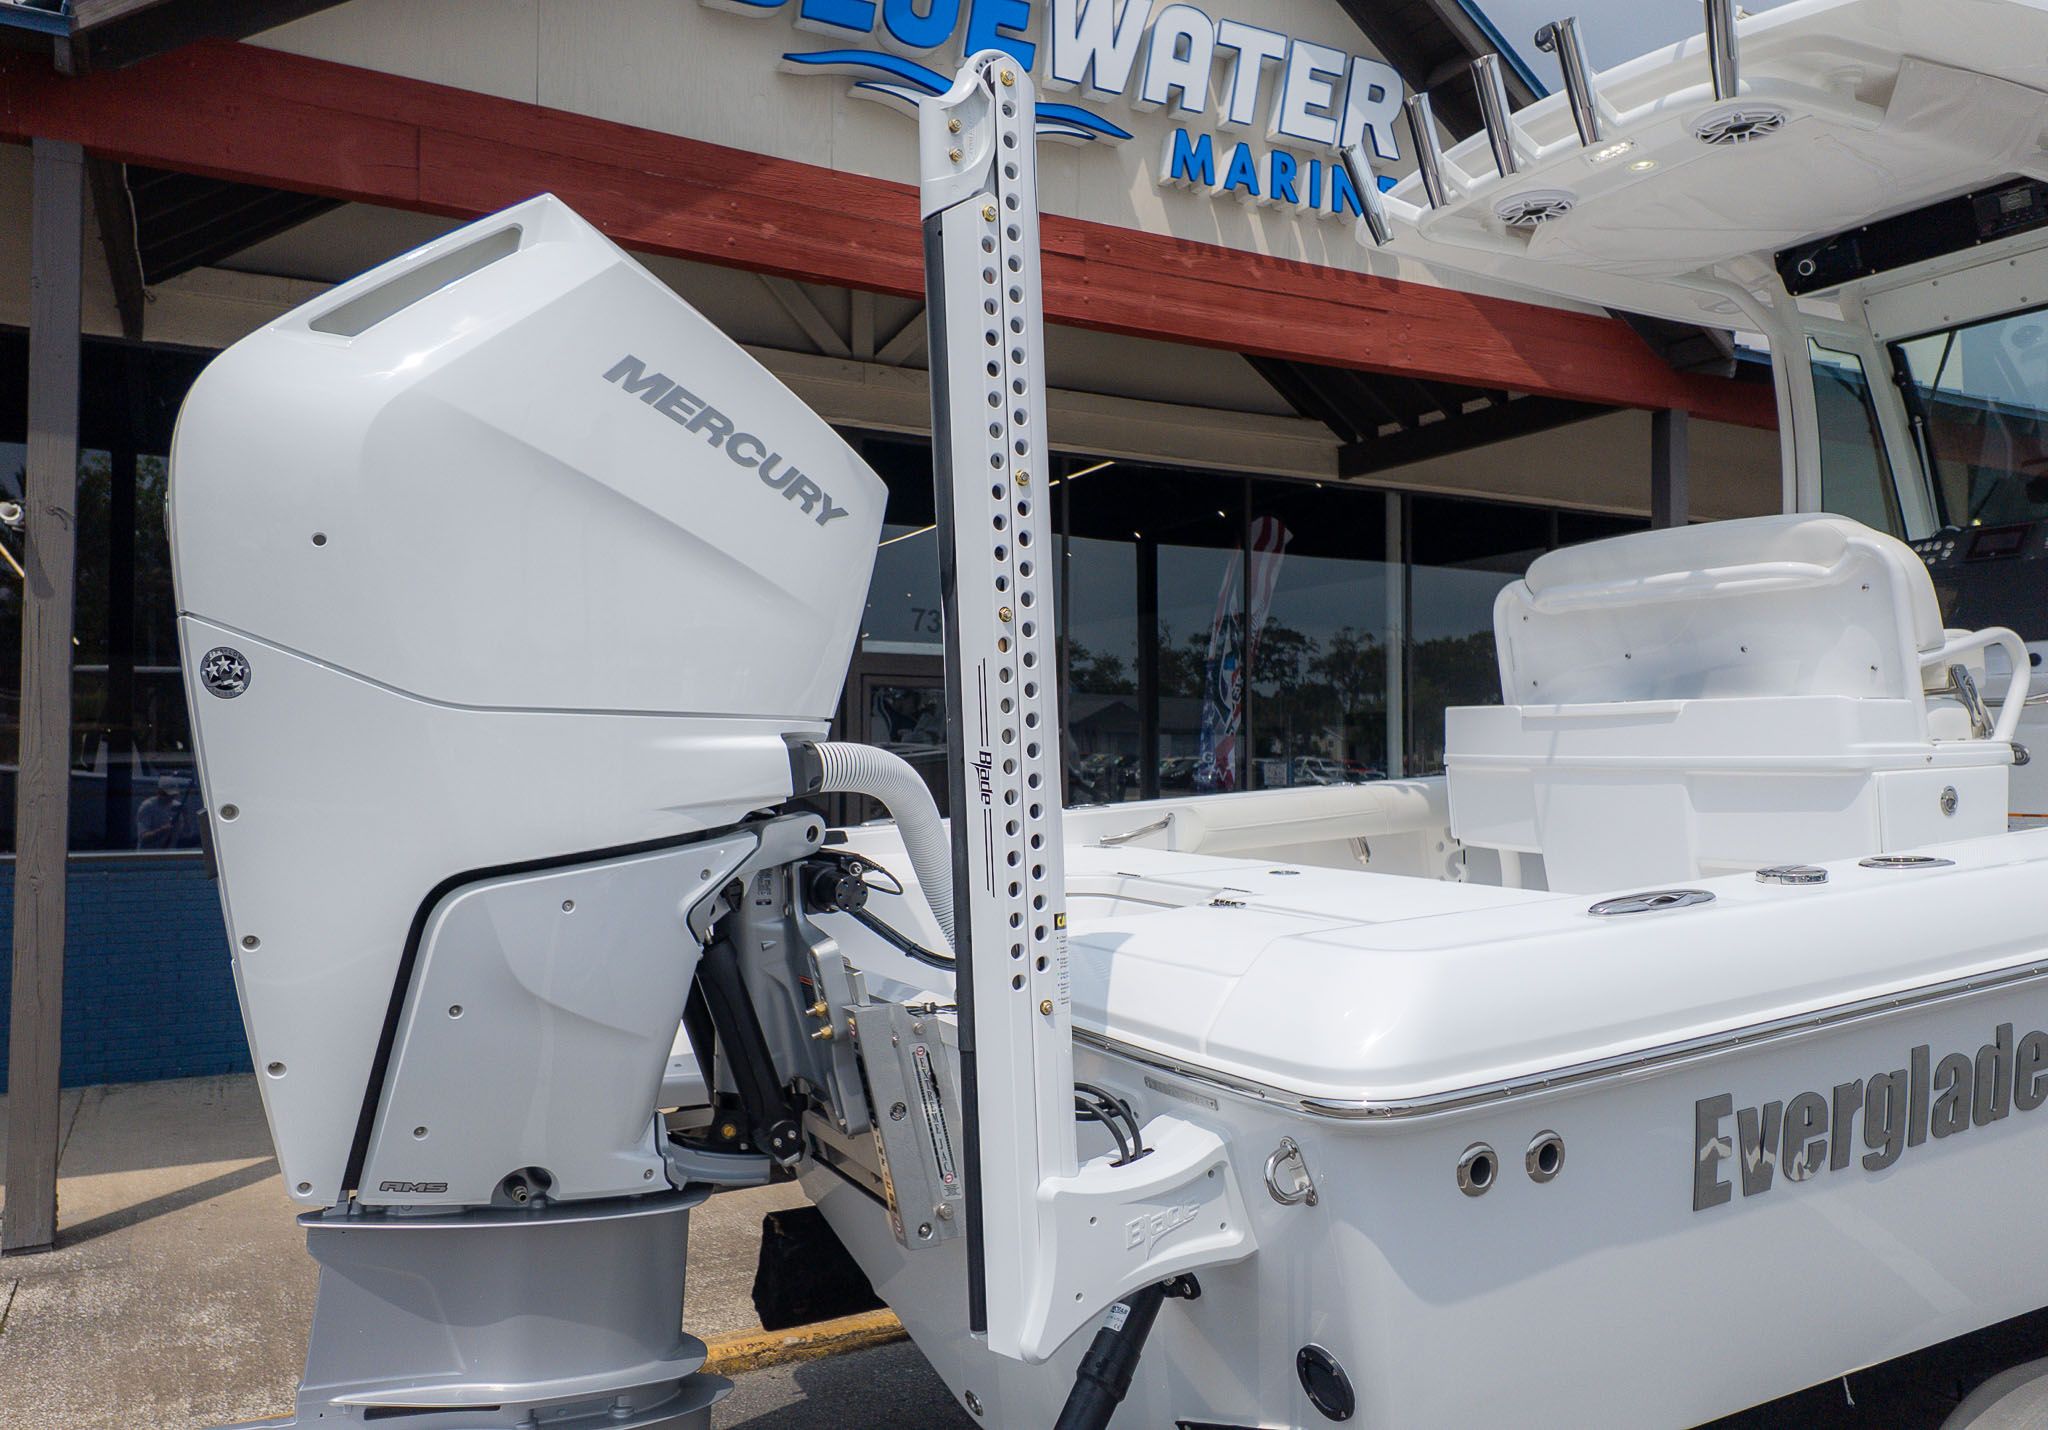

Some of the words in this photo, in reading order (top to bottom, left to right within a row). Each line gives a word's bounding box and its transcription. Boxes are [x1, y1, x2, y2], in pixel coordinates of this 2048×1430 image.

[1051, 0, 1404, 161] WATER
[1170, 127, 1398, 218] MARIN
[602, 354, 849, 527] MERCURY
[969, 750, 993, 805] Blade
[1693, 1021, 2048, 1212] Everglade
[379, 1181, 448, 1193] AMS
